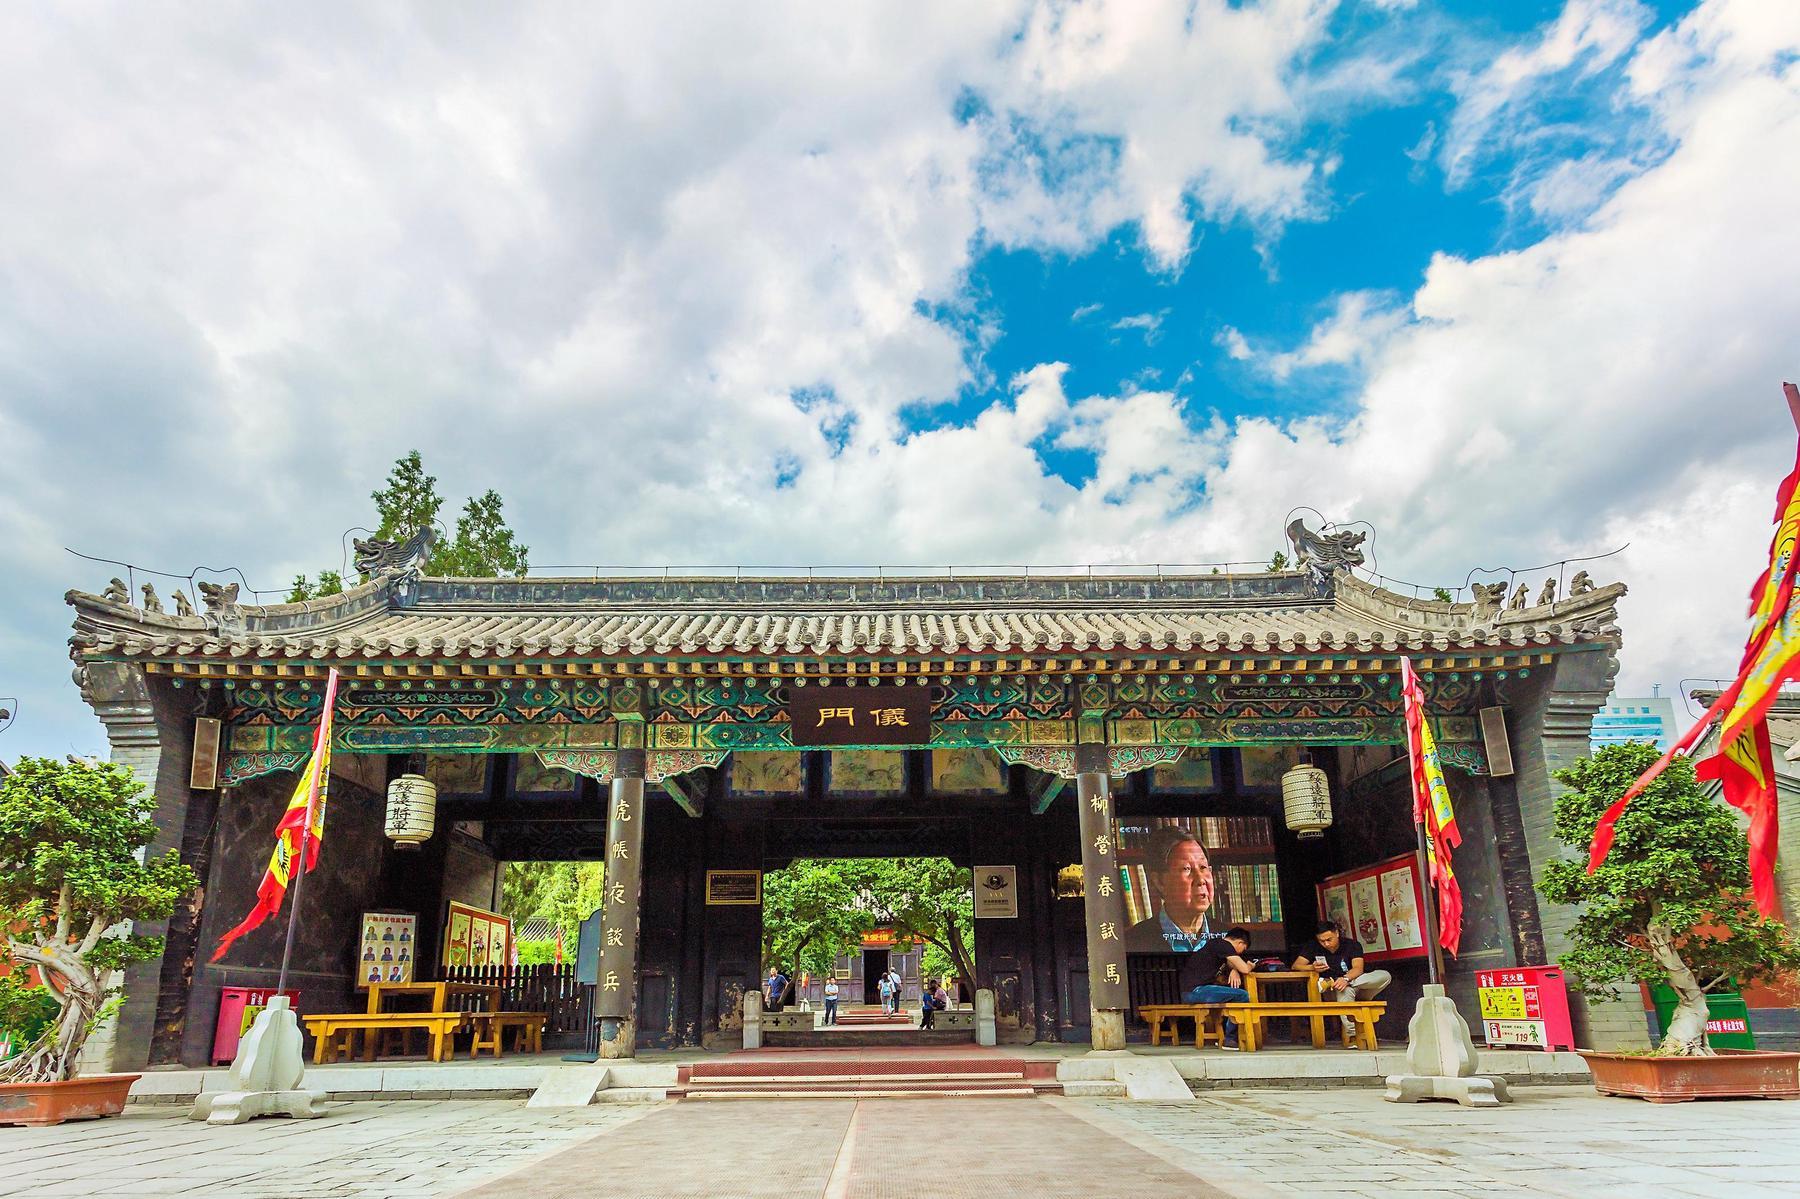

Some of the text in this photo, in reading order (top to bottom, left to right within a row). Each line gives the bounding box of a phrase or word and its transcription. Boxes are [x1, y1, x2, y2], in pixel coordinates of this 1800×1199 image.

[603, 799, 631, 992] 虎帳夜談兵
[1090, 794, 1120, 985] 柳營春試馬
[1501, 973, 1524, 982] 灭火器
[1515, 1033, 1528, 1042] 119
